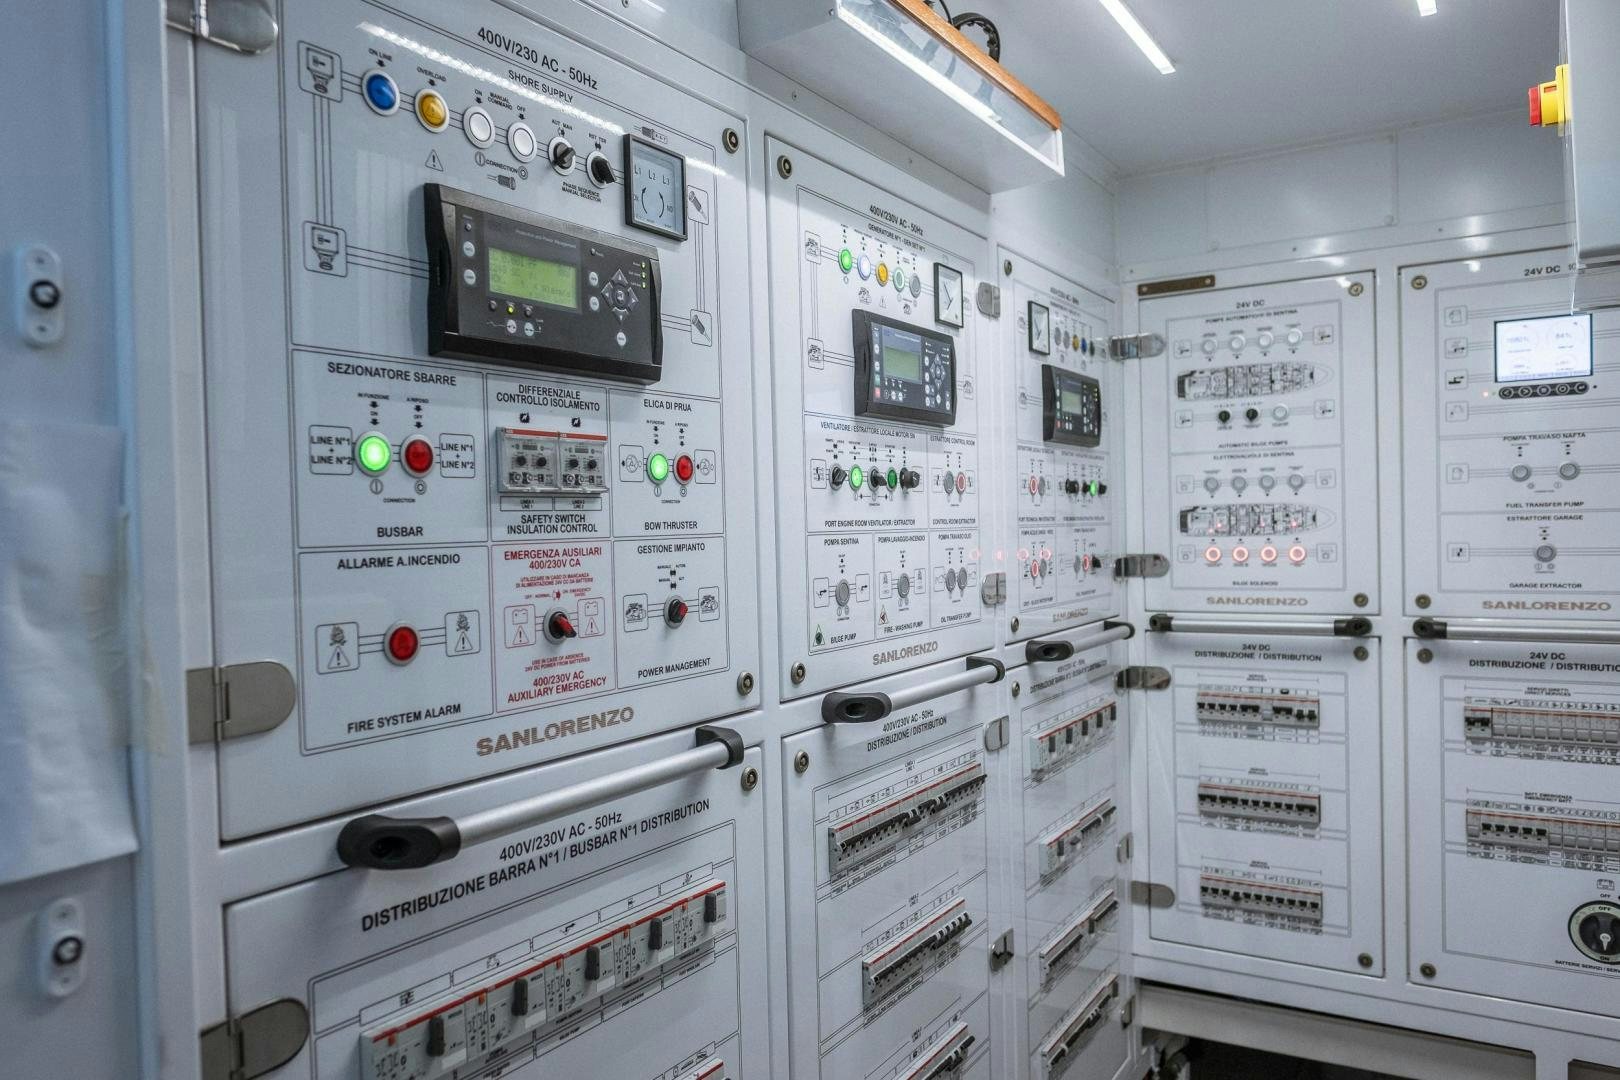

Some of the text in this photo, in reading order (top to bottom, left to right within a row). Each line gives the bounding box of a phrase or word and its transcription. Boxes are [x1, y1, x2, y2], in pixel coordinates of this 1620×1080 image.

[478, 28, 538, 64] 400V/230
[542, 58, 559, 73] AC
[569, 68, 598, 90] 50Hz
[416, 66, 446, 82] OVERLOAD
[508, 70, 573, 103] SHORE SUPPLY
[486, 158, 518, 174] CONNECTION
[870, 204, 923, 236] 400V/230V AC 50Hz
[868, 223, 894, 239] GENERATORE
[1524, 267, 1543, 276] 24V
[1546, 265, 1561, 274] DC
[1236, 301, 1251, 309] 24V
[328, 362, 456, 386] SEZIONATORE SBARRE
[518, 384, 580, 400] DIFFERENZIALE
[496, 392, 600, 412] CONTROLLO ISOLAMENTO
[644, 399, 692, 412] ELICA DI PRUA
[821, 422, 850, 432] VENTILATORE
[880, 428, 894, 437] LOCALE
[310, 436, 332, 445] LINE
[441, 443, 458, 451] LINE
[310, 456, 333, 464] LINE
[442, 460, 459, 468] LINE
[521, 514, 586, 524] SAFETY SWITCH
[644, 521, 698, 531] BOW THRUSTER
[377, 526, 424, 538] BUSBAR
[507, 524, 598, 534] INSULATION CONTROL
[504, 547, 602, 560] EMERGENZA AUSILIARI
[637, 543, 706, 554] GESTIONE IMPIANTO
[337, 554, 460, 570] ALLARME A.INCENDIO
[529, 558, 581, 570] 400/230V CA
[1206, 597, 1308, 606] SANLORENZO
[1482, 600, 1611, 611] SANLORENZO
[830, 633, 857, 644] BILGE PUMP
[873, 641, 938, 666] SANLORENZO
[1195, 651, 1255, 659] DISTRIBUZIONE
[1263, 653, 1322, 661] DISTRIBUTION
[638, 658, 711, 678] POWER MANAGEMENT
[1469, 660, 1546, 669] DISTRIBUZIONE
[533, 670, 584, 687] 400/230V AC
[508, 676, 607, 703] AUXILIARY EMERGENCY
[347, 703, 461, 734] FIRE SYSTEM ALARM
[883, 716, 910, 732] 400V/230V
[921, 709, 934, 720] 50Hz
[476, 706, 634, 757] SANLORENZO
[867, 716, 947, 752] DISTRIBUZIONE DISTRIBUTION
[500, 826, 566, 861] 400V/230V
[568, 821, 585, 838] AC
[594, 812, 622, 831] 50Hz
[362, 799, 710, 932] DISTRIBUZIONE BARRA N°1 / BUSBAR N°1 DISTRIBUTION
